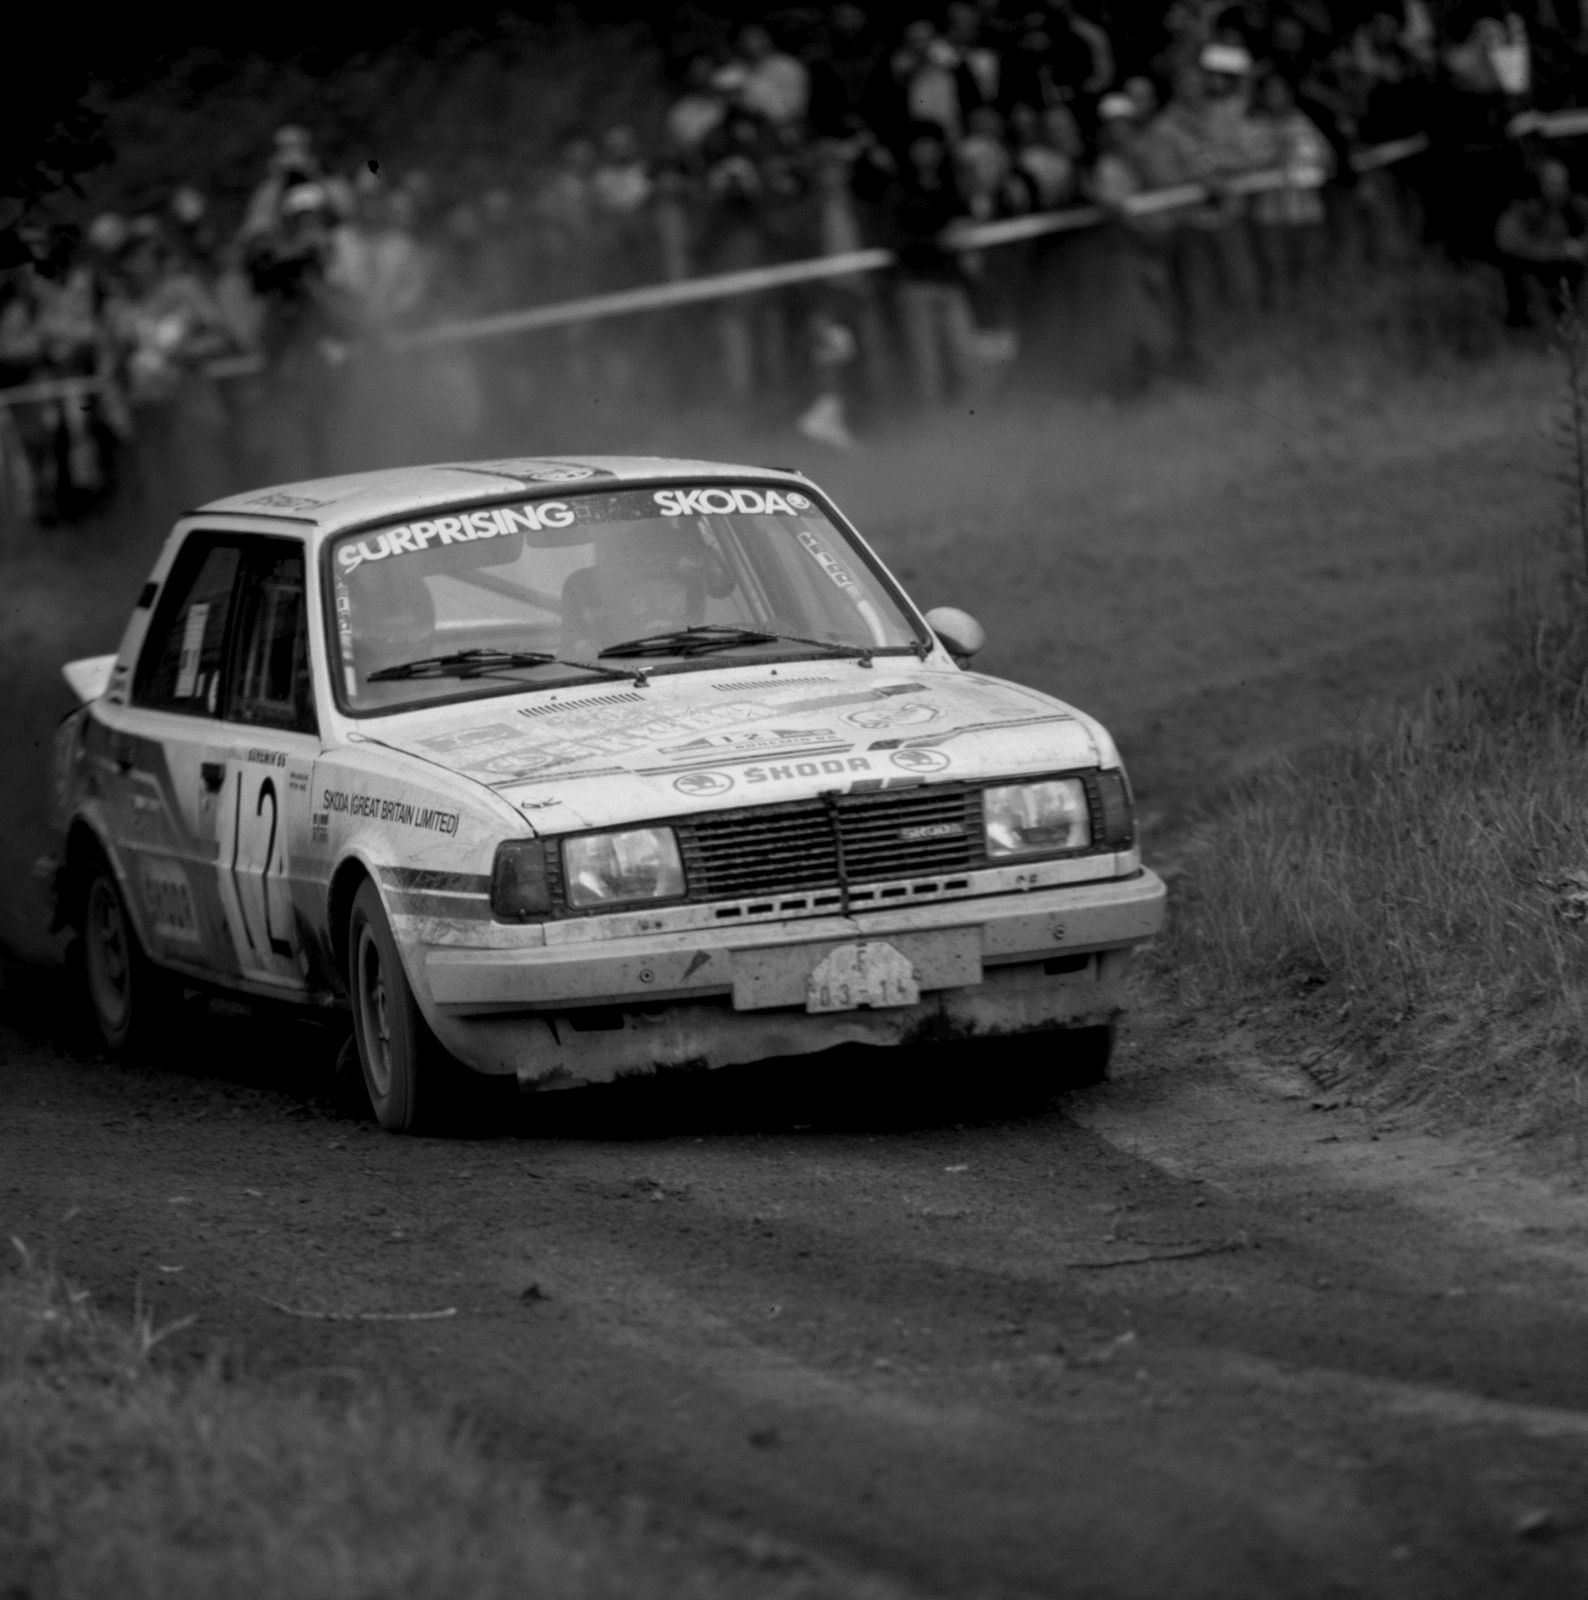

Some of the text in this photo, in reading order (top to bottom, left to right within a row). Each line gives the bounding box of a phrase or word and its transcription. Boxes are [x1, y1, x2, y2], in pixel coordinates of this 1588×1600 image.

[339, 489, 798, 574] SURPRISING SKODA
[743, 756, 871, 784] ŠKODA
[323, 789, 459, 837] SKODA (GREAT BRITAIN LIMITED)
[230, 770, 293, 958] 12
